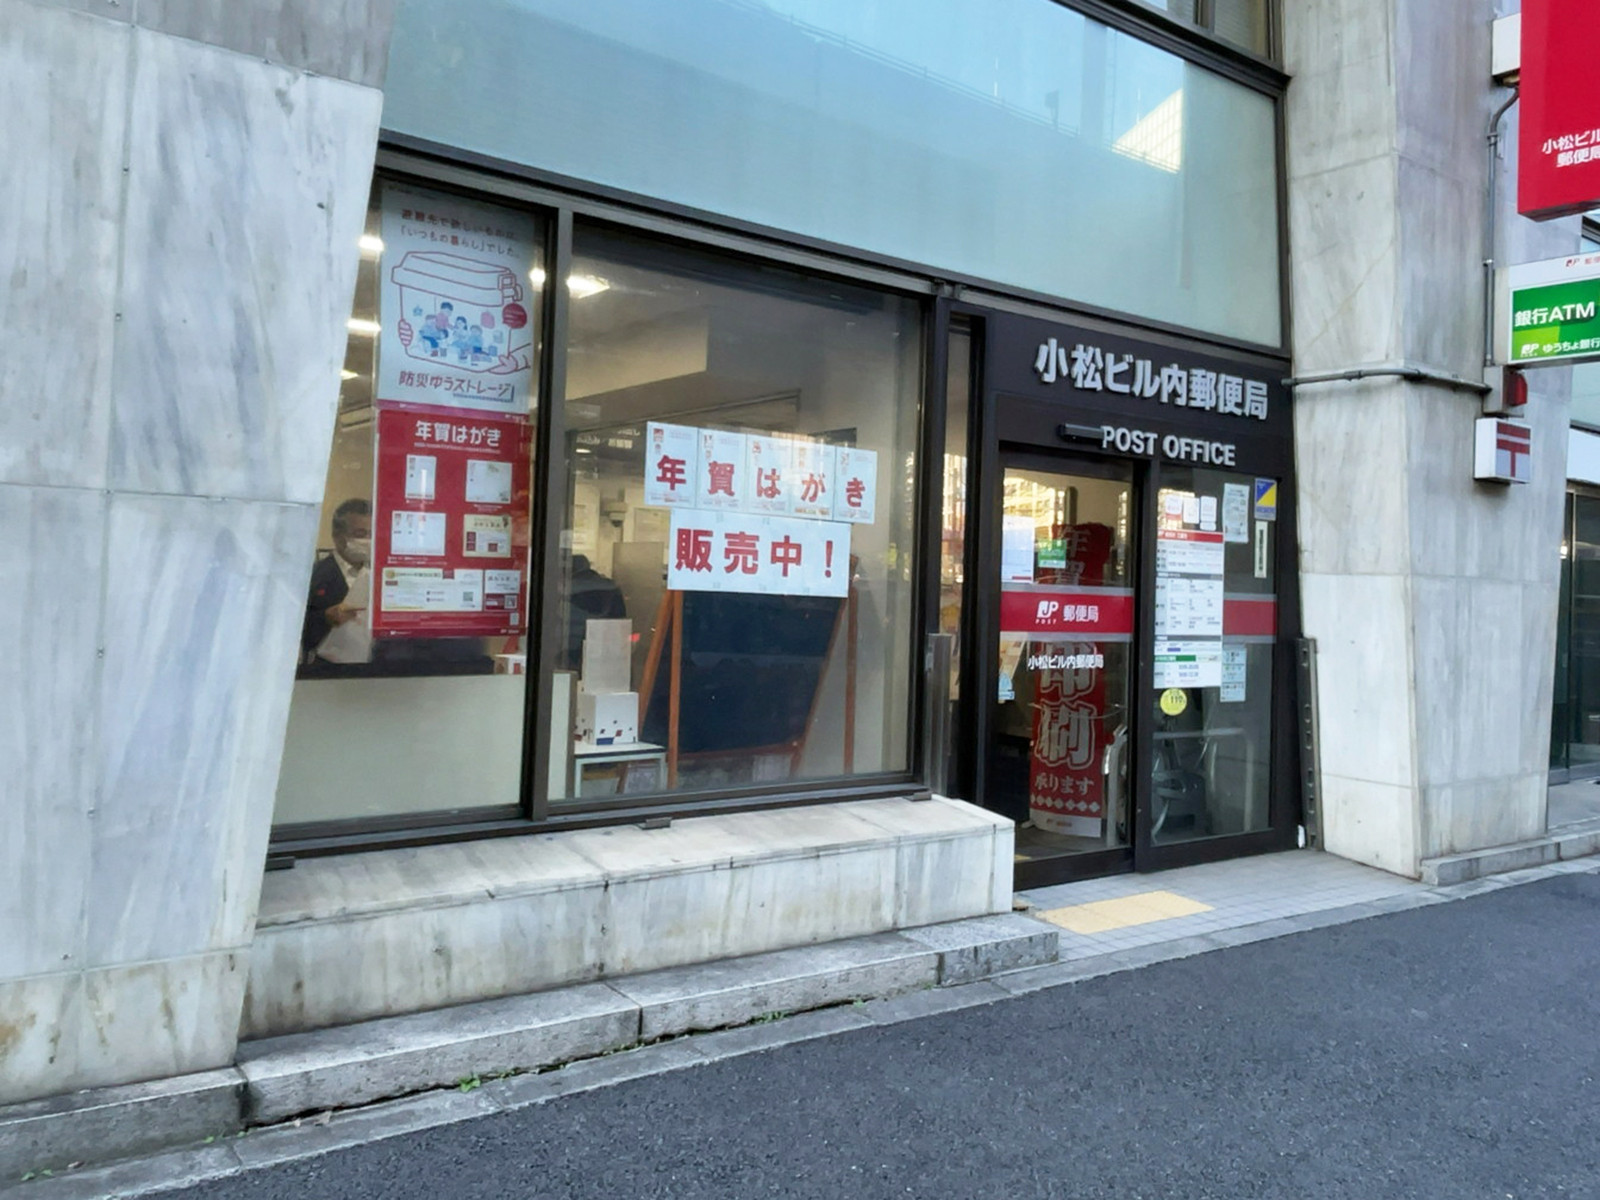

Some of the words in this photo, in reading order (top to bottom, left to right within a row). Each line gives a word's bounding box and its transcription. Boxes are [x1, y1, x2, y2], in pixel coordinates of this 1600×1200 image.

[1514, 301, 1596, 328] 銀行ATM
[398, 371, 512, 398] 防災ゆうストレージ
[1034, 337, 1269, 421] 小松ビル内郵便局
[415, 420, 502, 447] 年賀はがき
[1101, 425, 1158, 456] POST
[1162, 435, 1236, 467] OFFICE
[656, 454, 867, 508] 年賀はがき
[1063, 604, 1099, 623] 郵便局
[1027, 653, 1104, 671] 小松ビル内郵便局
